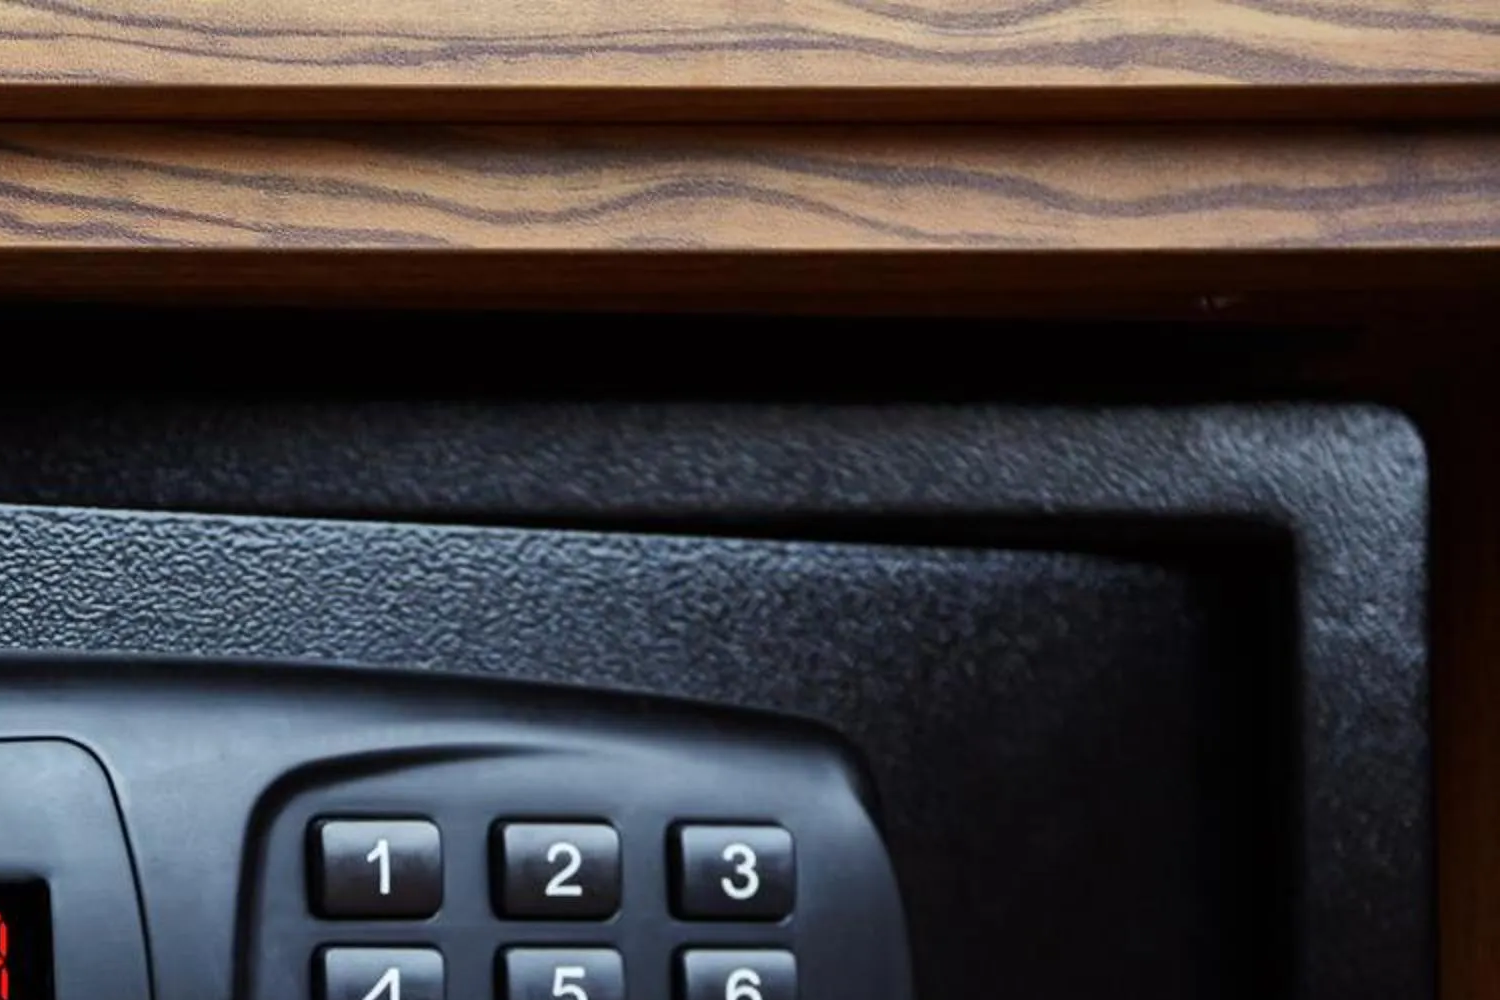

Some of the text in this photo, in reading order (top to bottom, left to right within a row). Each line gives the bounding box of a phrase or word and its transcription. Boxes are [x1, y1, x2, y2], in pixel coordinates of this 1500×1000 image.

[366, 838, 391, 895] 1
[545, 841, 584, 897] 2
[720, 842, 760, 900] 3
